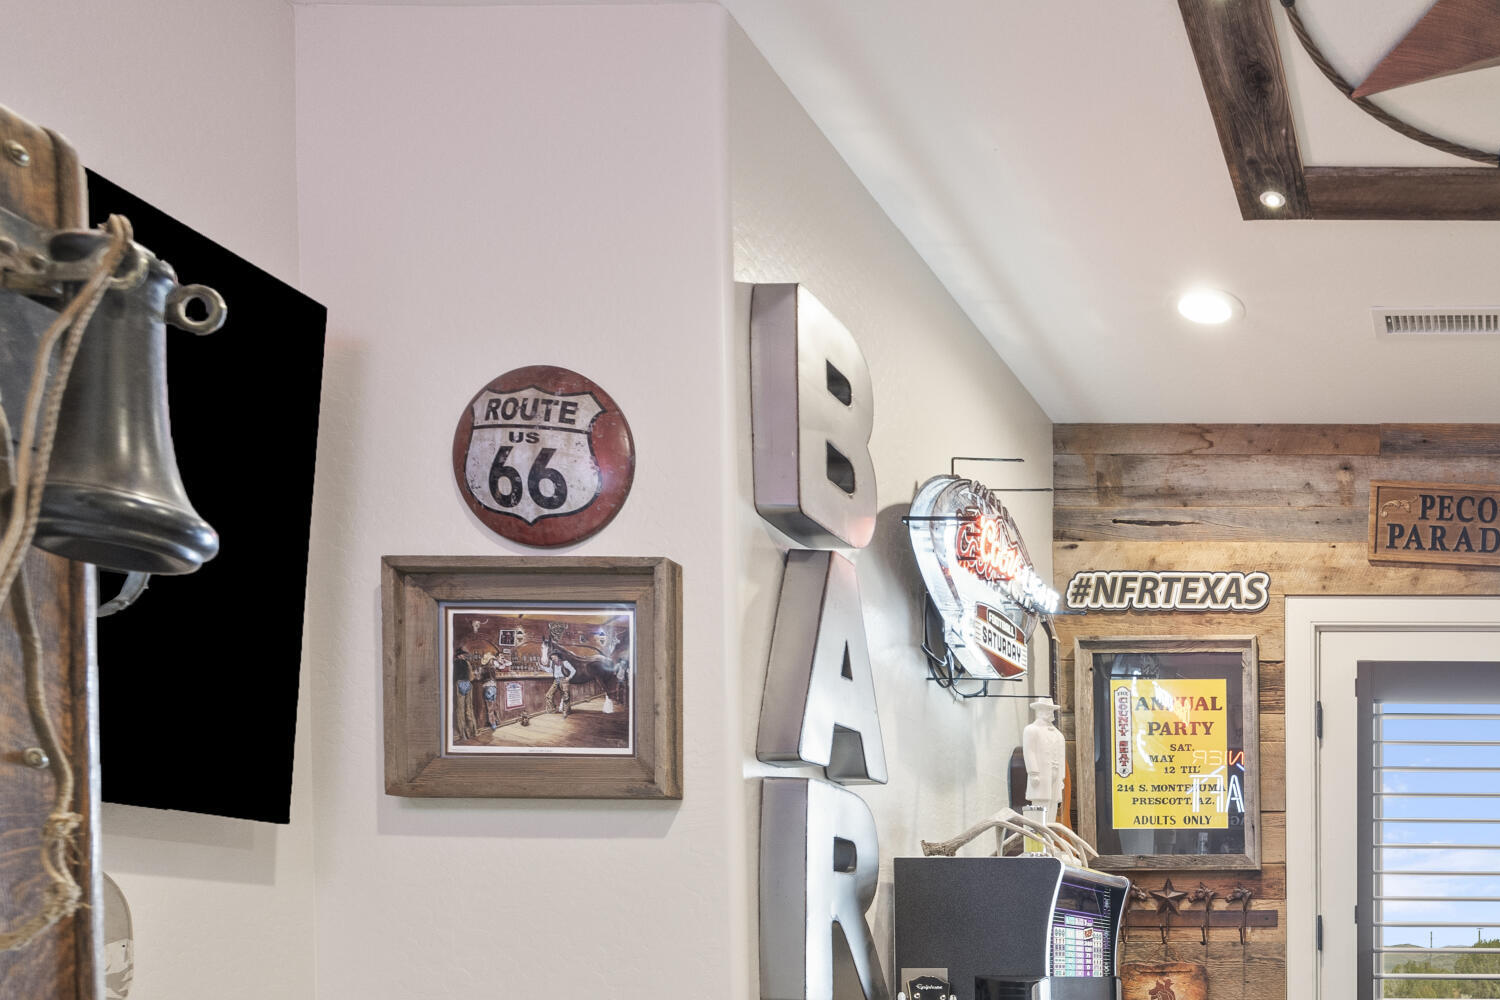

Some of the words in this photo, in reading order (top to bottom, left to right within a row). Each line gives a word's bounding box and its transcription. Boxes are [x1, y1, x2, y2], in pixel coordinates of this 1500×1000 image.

[484, 396, 580, 426] ROUTE
[509, 430, 540, 444] US
[488, 445, 570, 510] 66
[1070, 574, 1267, 607] #NFRTEXAS
[982, 626, 1021, 662] SATURDAY
[1135, 696, 1223, 711] ANUAL
[1147, 721, 1215, 736] PARTY
[1169, 743, 1195, 752] SAT.
[1150, 755, 1175, 763] MAY
[1164, 766, 1176, 774] 12
[1117, 784, 1135, 792] 214
[1133, 816, 1177, 826] ADULTS
[1183, 816, 1212, 826] ONLY
